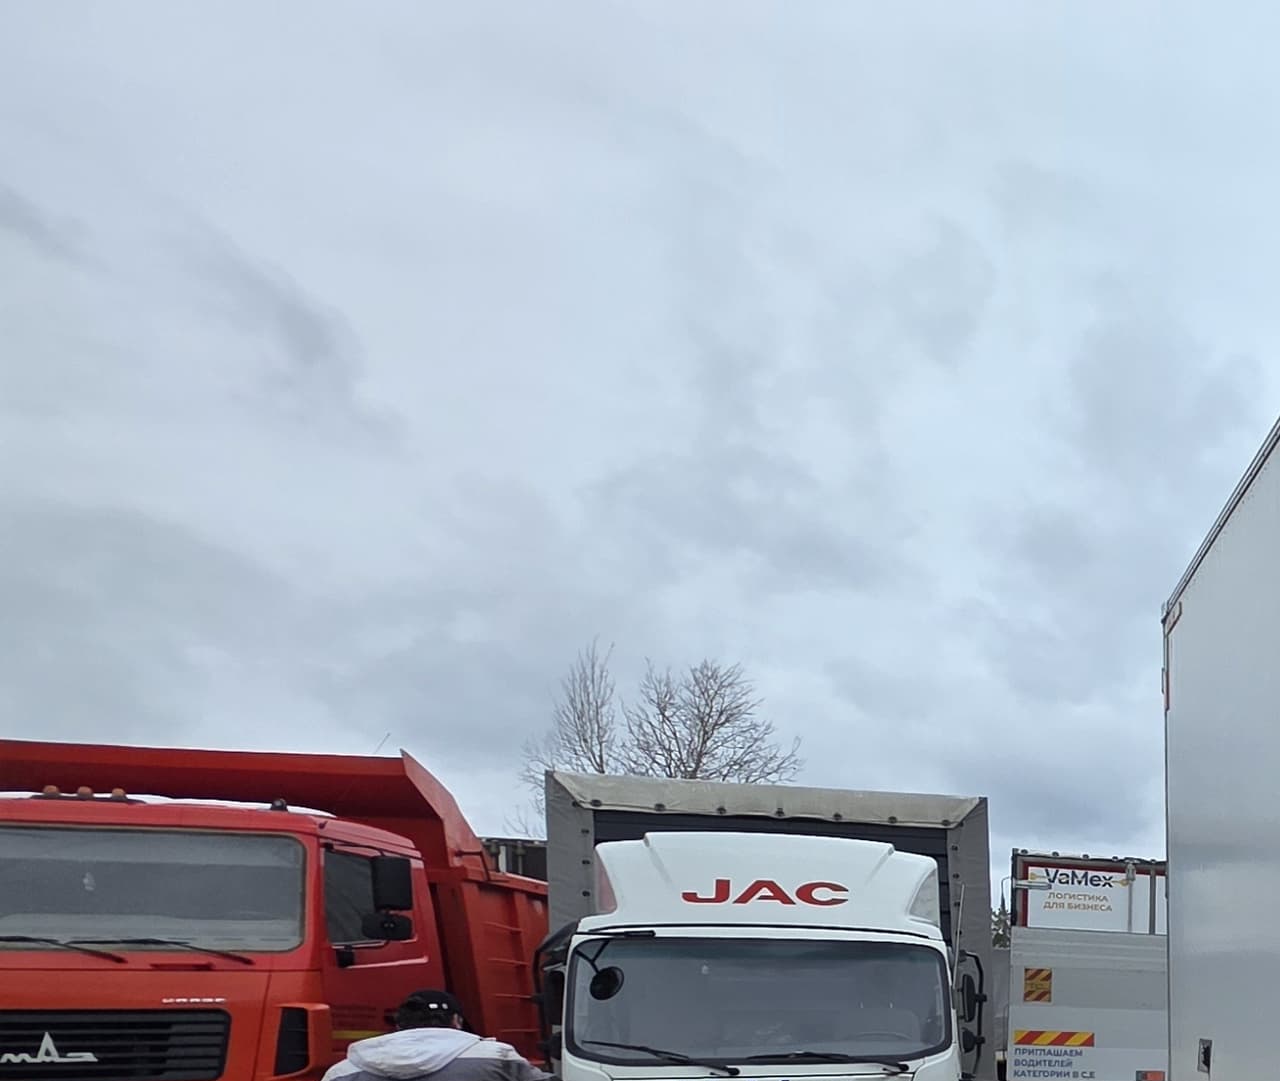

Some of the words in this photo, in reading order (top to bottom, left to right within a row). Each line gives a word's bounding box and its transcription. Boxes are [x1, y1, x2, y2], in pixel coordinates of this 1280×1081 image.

[1045, 869, 1114, 888] VaMex
[681, 879, 849, 906] JAC
[1048, 892, 1109, 902] ЛОГИСТИКА
[1043, 901, 1065, 909] ДЛЯ
[1067, 903, 1112, 912] БИЗНЕСА
[1014, 1047, 1083, 1057] ПРИГЛАШАЕМ
[1014, 1057, 1073, 1068] ВОДИТЕЛЕЙ
[1013, 1069, 1071, 1078] КАТЕГОРИИ
